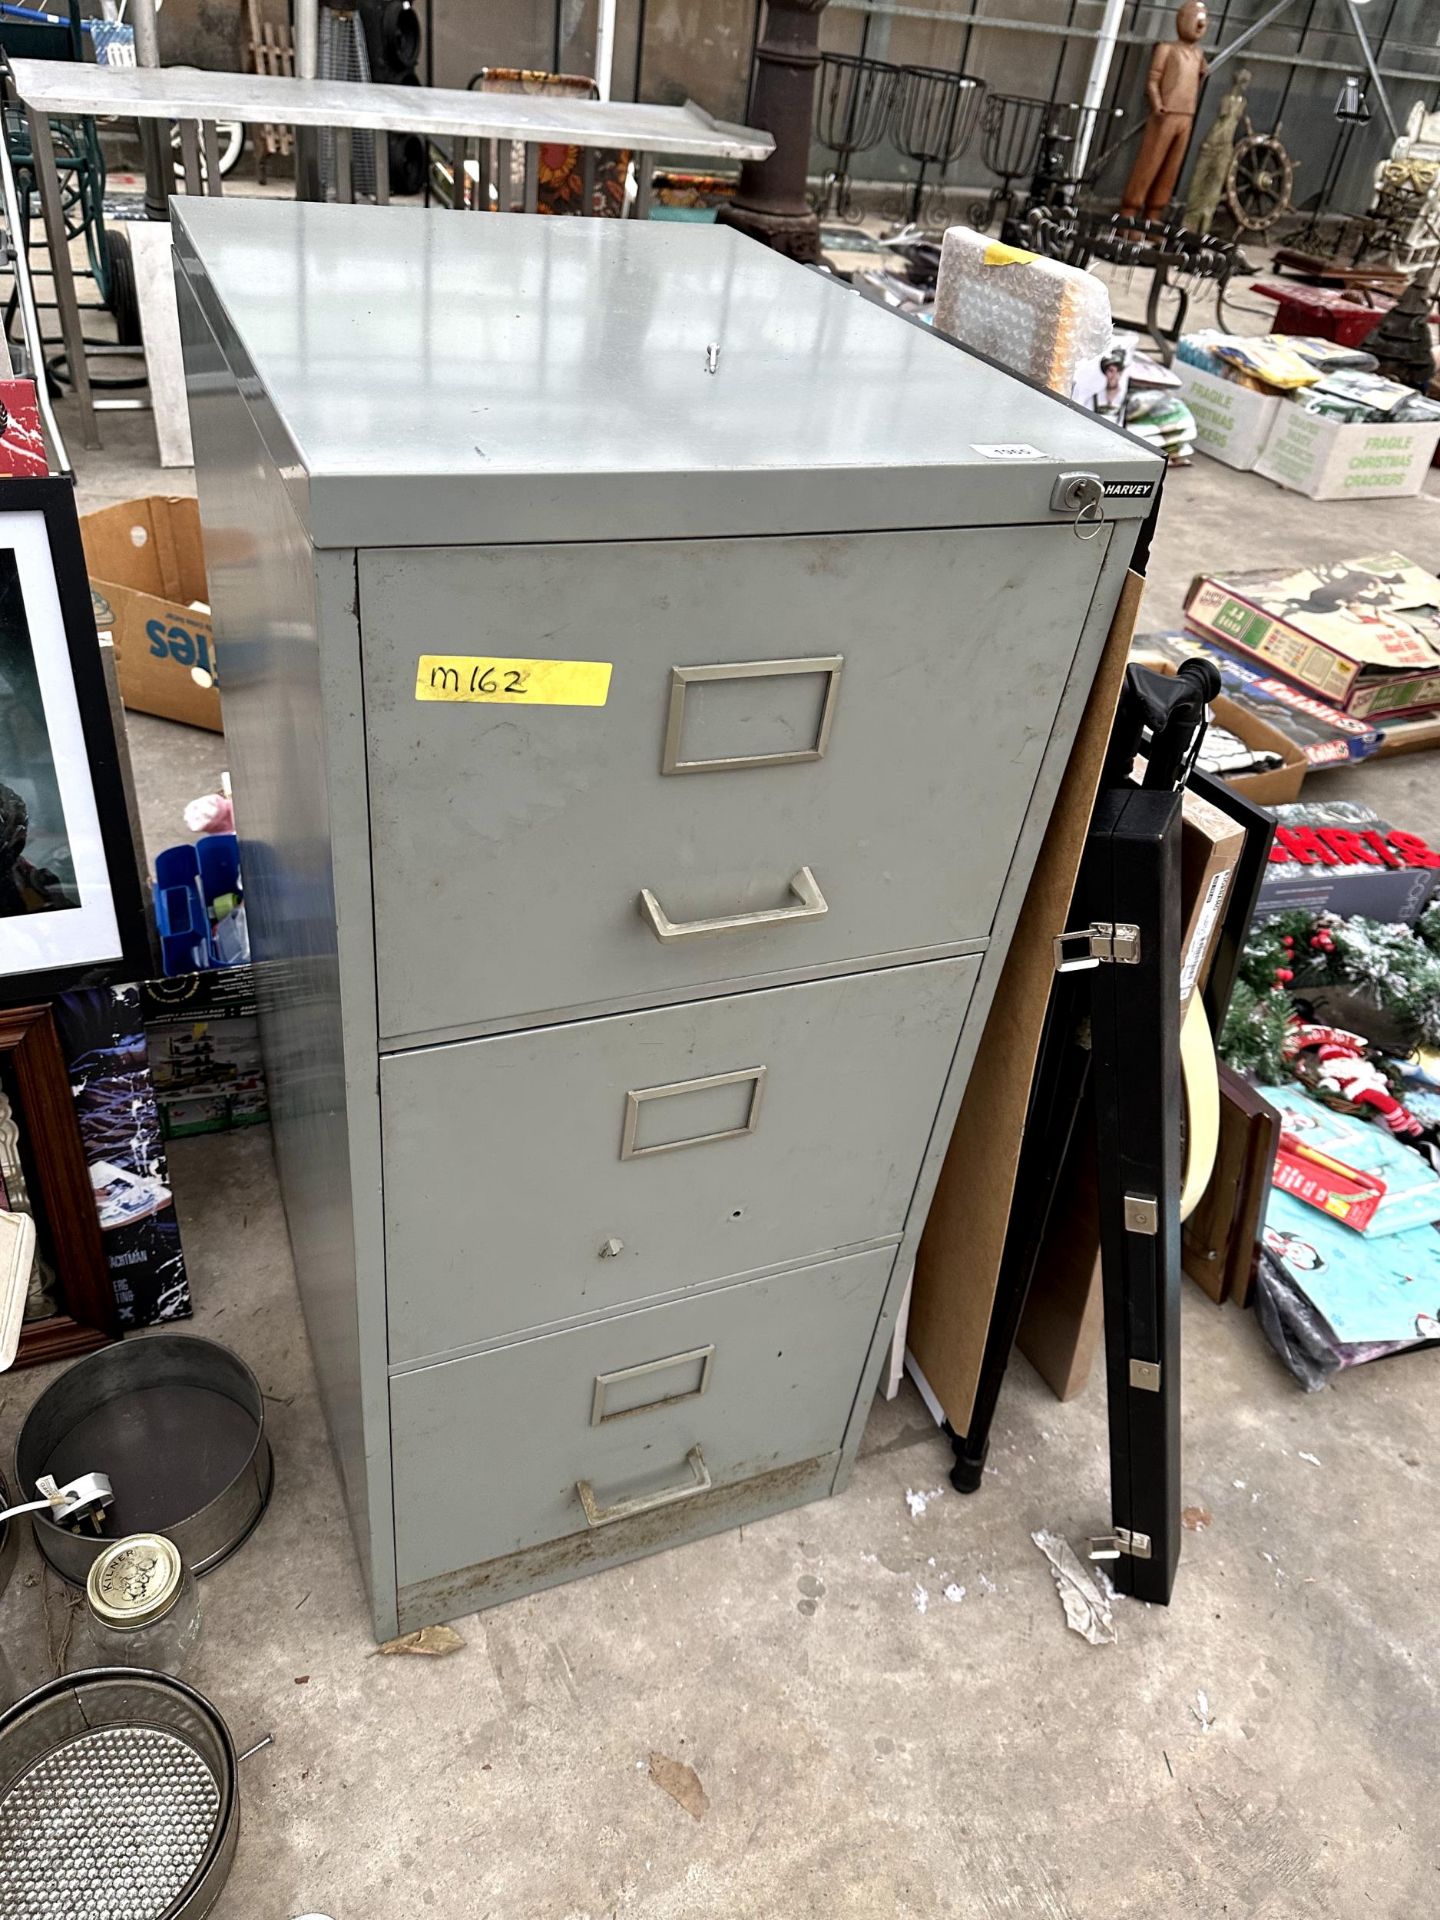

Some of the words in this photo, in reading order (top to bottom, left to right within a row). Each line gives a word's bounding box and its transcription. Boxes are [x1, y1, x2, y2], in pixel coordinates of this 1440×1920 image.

[1364, 436, 1415, 450] FRAGILE
[1349, 455, 1414, 469] CHRISTMAS
[1104, 484, 1152, 495] HARVEY
[1269, 825, 1440, 869] HRIS
[103, 1549, 135, 1592] KILNER
